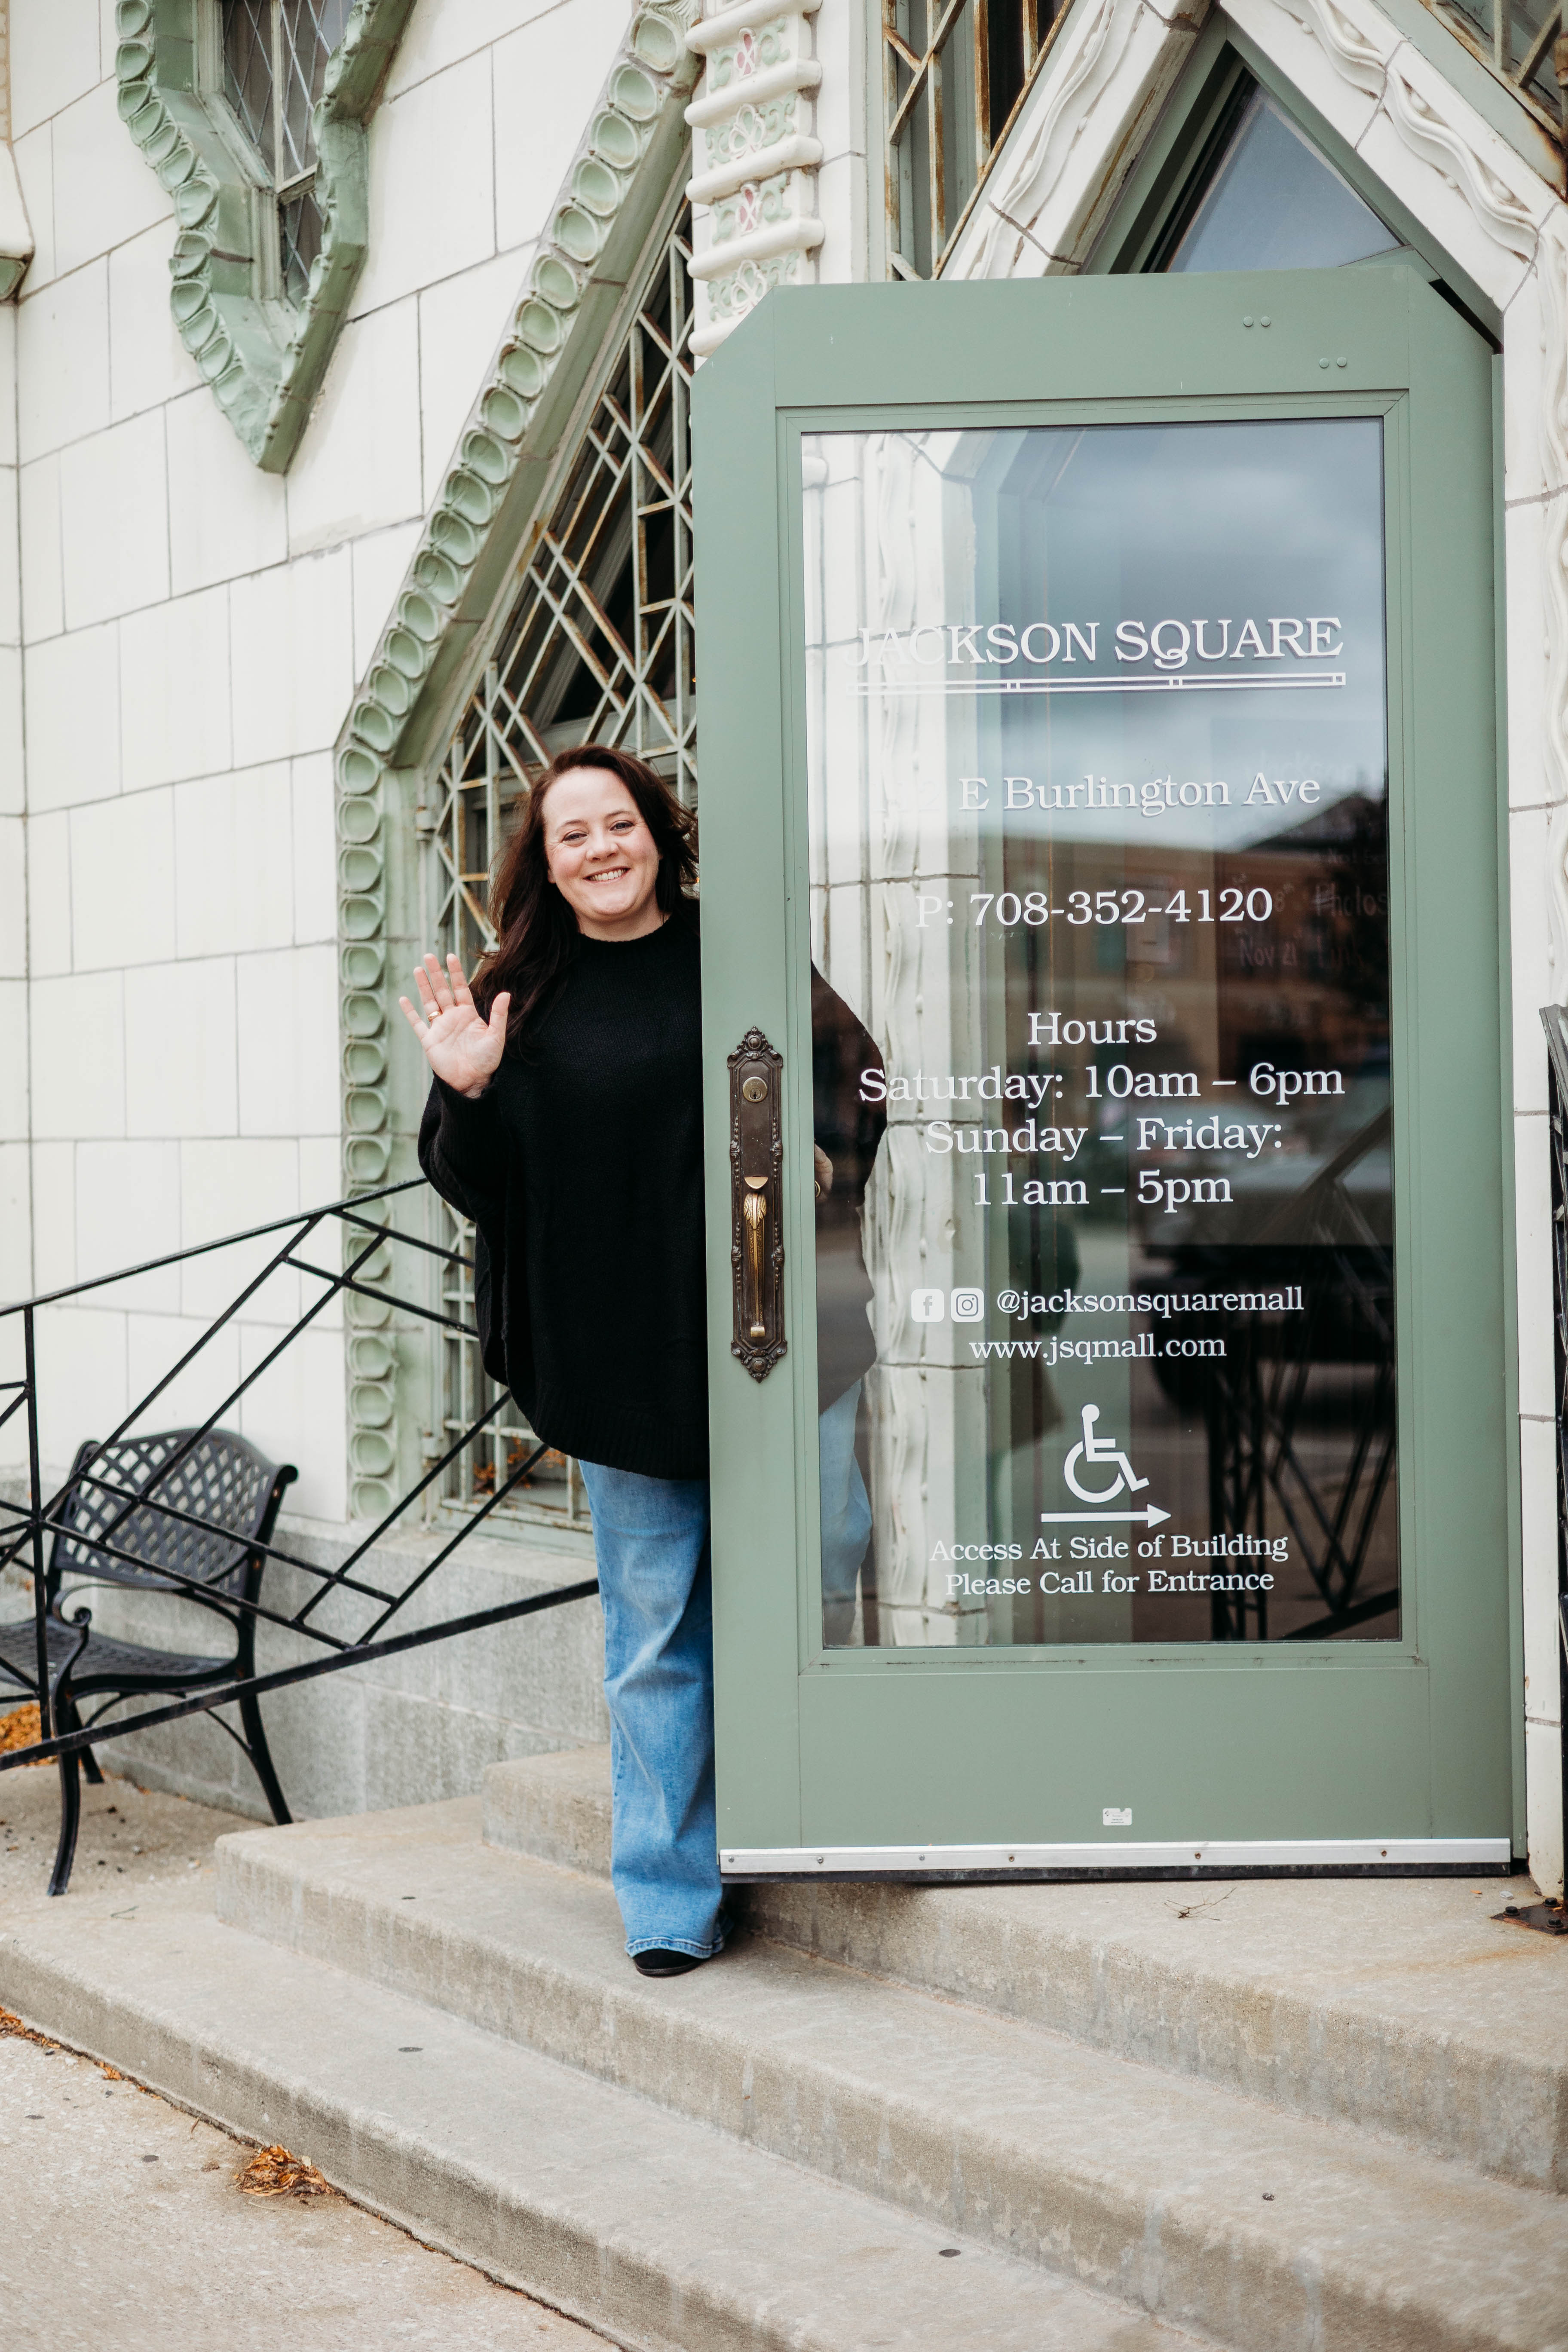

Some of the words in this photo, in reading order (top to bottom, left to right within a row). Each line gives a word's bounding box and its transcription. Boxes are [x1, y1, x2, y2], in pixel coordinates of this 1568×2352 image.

[843, 623, 1099, 665] JACKSON
[1115, 617, 1344, 670] SQUARE
[958, 778, 988, 811] E
[1003, 775, 1231, 817] Burlington
[1243, 772, 1320, 805] Ave
[916, 895, 954, 928] P:
[970, 888, 1273, 926] 708-352-4120
[1027, 1012, 1157, 1045] Hours
[858, 1066, 1063, 1109] Saturday:
[1086, 1064, 1201, 1097] 10am
[1250, 1063, 1344, 1105] 6pm
[926, 1118, 1088, 1161] Sunday
[1136, 1116, 1283, 1158] Friday:
[974, 1173, 1089, 1206] 11am
[1138, 1170, 1233, 1213] 5pm
[997, 1286, 1304, 1321] @jacksonsquaremall
[969, 1334, 1227, 1365] www.jsqmall.com
[929, 1540, 1023, 1562] Access
[1030, 1537, 1062, 1559] At
[1069, 1536, 1129, 1559] Side
[1138, 1535, 1162, 1558] of
[1171, 1534, 1289, 1562] Building
[946, 1574, 1031, 1596] Please
[1039, 1571, 1093, 1594] Call
[1102, 1571, 1140, 1593] for
[1148, 1570, 1274, 1592] Entrance
